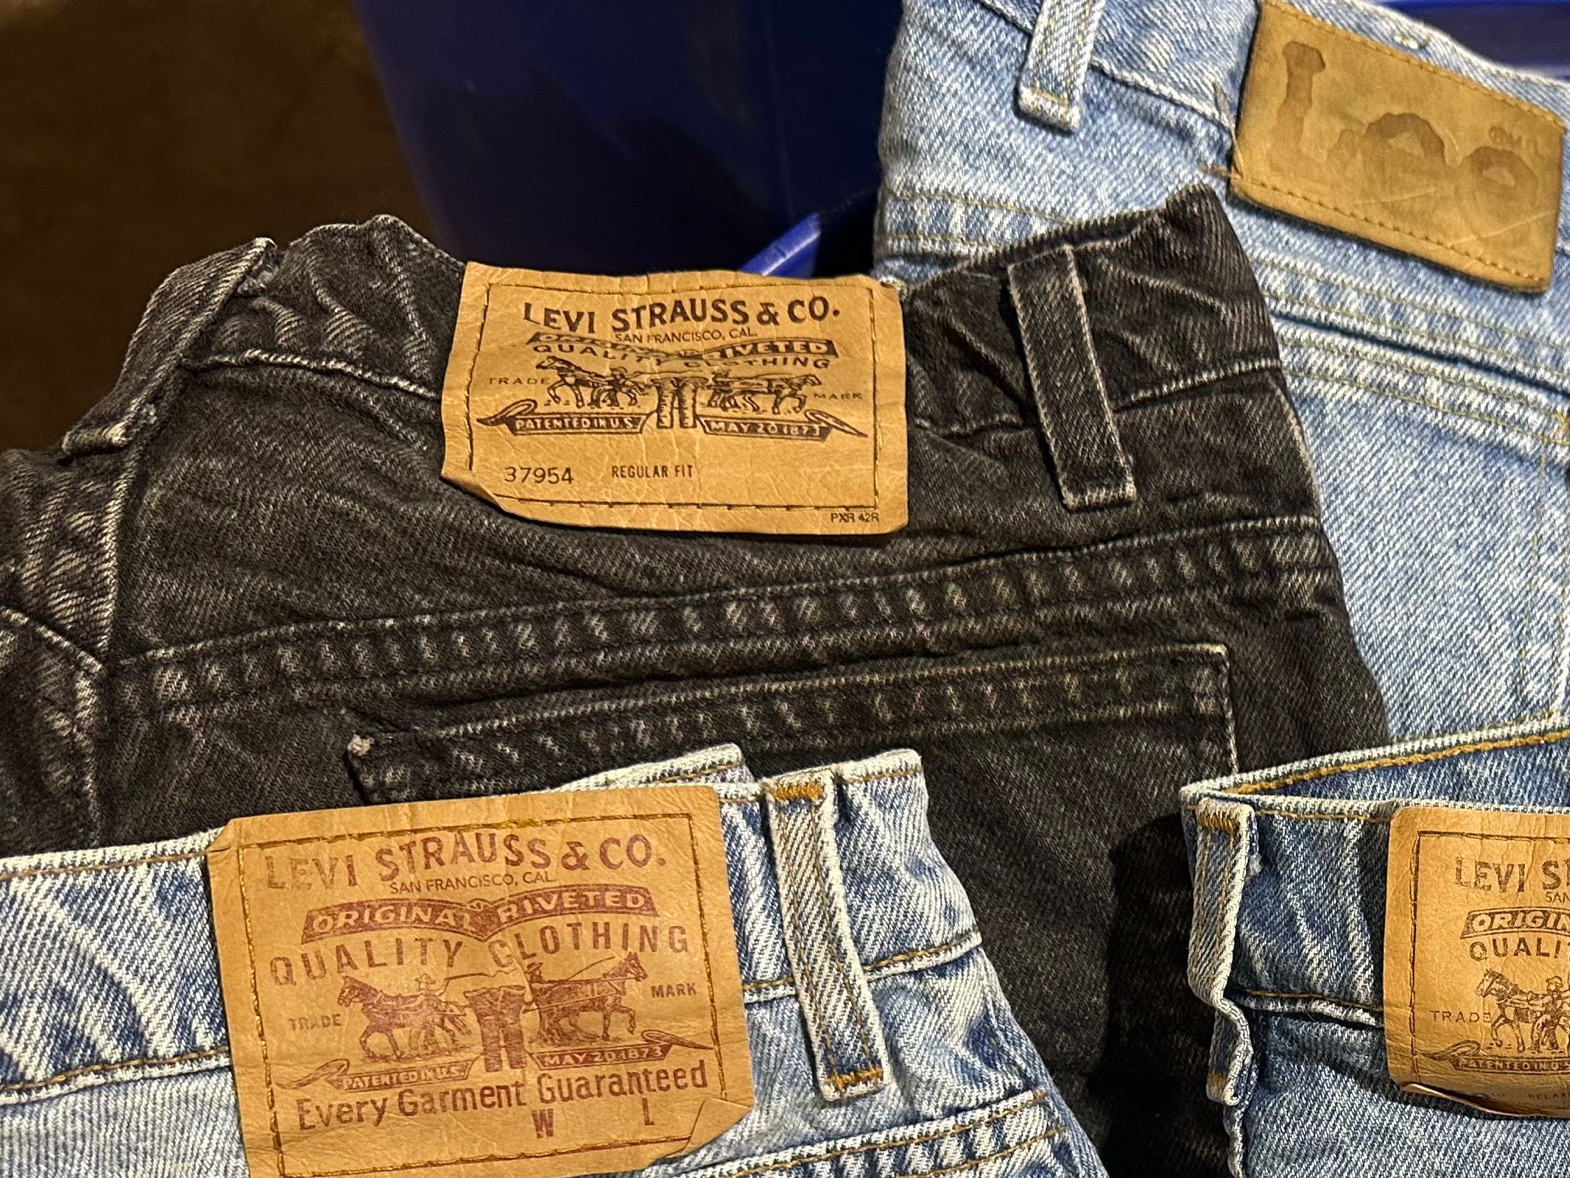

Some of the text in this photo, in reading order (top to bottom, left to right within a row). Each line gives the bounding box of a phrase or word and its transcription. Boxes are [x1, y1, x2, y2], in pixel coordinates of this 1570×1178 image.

[523, 296, 840, 334] LEVI STRAUSS & CO.
[615, 328, 758, 344] SAN FRANCISCO, CAL.
[533, 344, 662, 366] QUALITY
[684, 356, 830, 369] CLOTHING
[488, 377, 550, 385] TRADE
[813, 392, 863, 400] MARK
[516, 418, 591, 430] PATENTED
[594, 417, 607, 428] IN
[711, 422, 820, 436] MAY 20 1873
[504, 464, 694, 485] 37954 REGULAR FIT
[265, 832, 666, 892] LEVI STRAUSS & CO.
[389, 871, 557, 895] SAN FRANCISCO, CAL.
[1454, 855, 1525, 893] LEVI
[312, 887, 646, 934] ORIGINAL RIVETED
[269, 920, 690, 987] QUALITY CLOTHING
[651, 982, 698, 999] MARK
[289, 1013, 342, 1032] TRADE
[1430, 1010, 1493, 1024] TRADE
[544, 1047, 663, 1066] MAY 20 1873
[1457, 1059, 1530, 1070] PATENTED
[1533, 1061, 1548, 1070] IN
[342, 1071, 419, 1090] PATENTED
[420, 1068, 435, 1081] IN
[297, 1060, 708, 1133] Every Garment Guaranteed
[533, 1098, 654, 1139] W L
